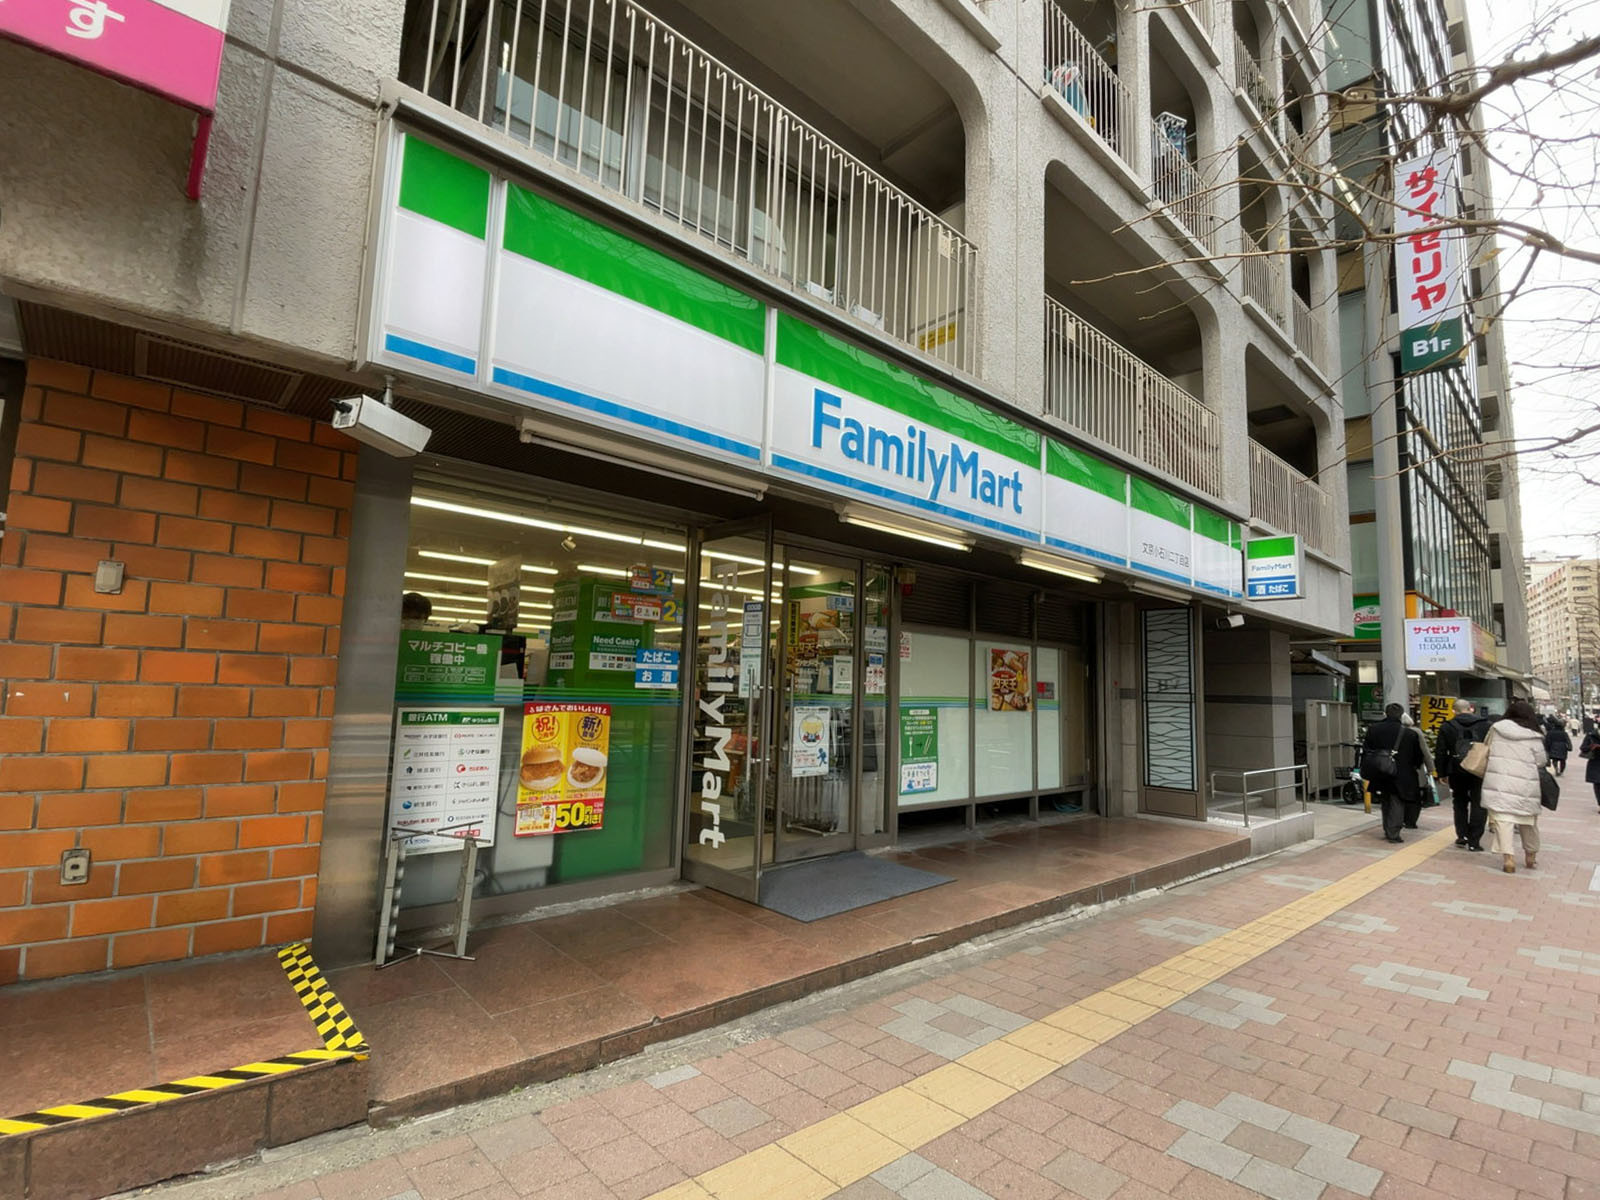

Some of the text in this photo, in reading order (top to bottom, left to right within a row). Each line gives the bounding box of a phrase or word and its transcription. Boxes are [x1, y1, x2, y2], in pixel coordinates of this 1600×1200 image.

[1404, 165, 1447, 312] サイゼリヤ
[1412, 335, 1452, 357] B1F
[811, 387, 1024, 514] FamilyMart
[1251, 562, 1292, 572] FamilyMart
[1268, 584, 1289, 594] たばこ
[1413, 626, 1460, 635] サイゼリヤ
[593, 635, 640, 646] Need Cash?
[1418, 643, 1456, 651] 11:00AM
[643, 651, 672, 663] たばこ
